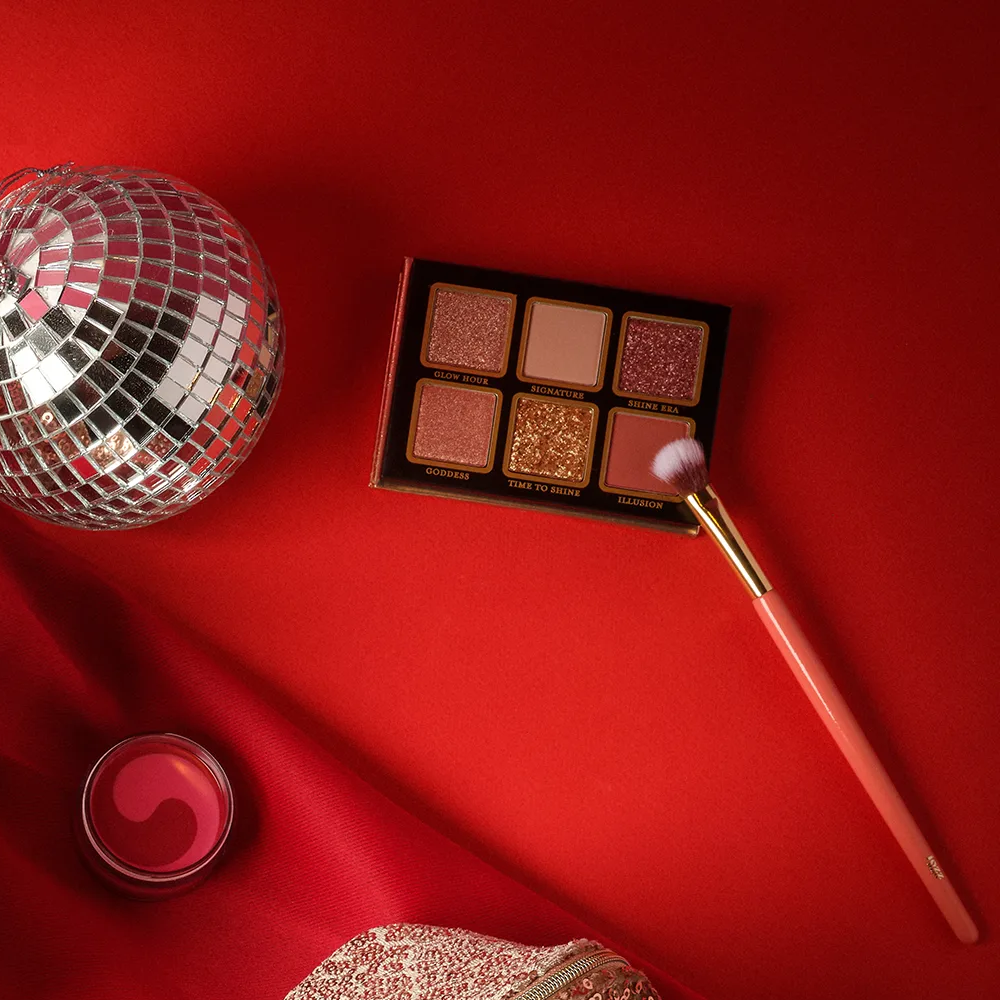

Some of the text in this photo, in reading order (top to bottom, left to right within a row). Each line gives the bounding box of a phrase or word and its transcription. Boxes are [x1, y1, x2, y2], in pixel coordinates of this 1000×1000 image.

[434, 371, 489, 386] GLOW HOUR
[530, 385, 585, 400] SIGNATURE
[628, 399, 680, 414] SHINE ERA
[425, 467, 470, 480] GODDESS
[507, 479, 581, 497] TIME TO SHINE
[617, 496, 664, 510] ILLUSION
